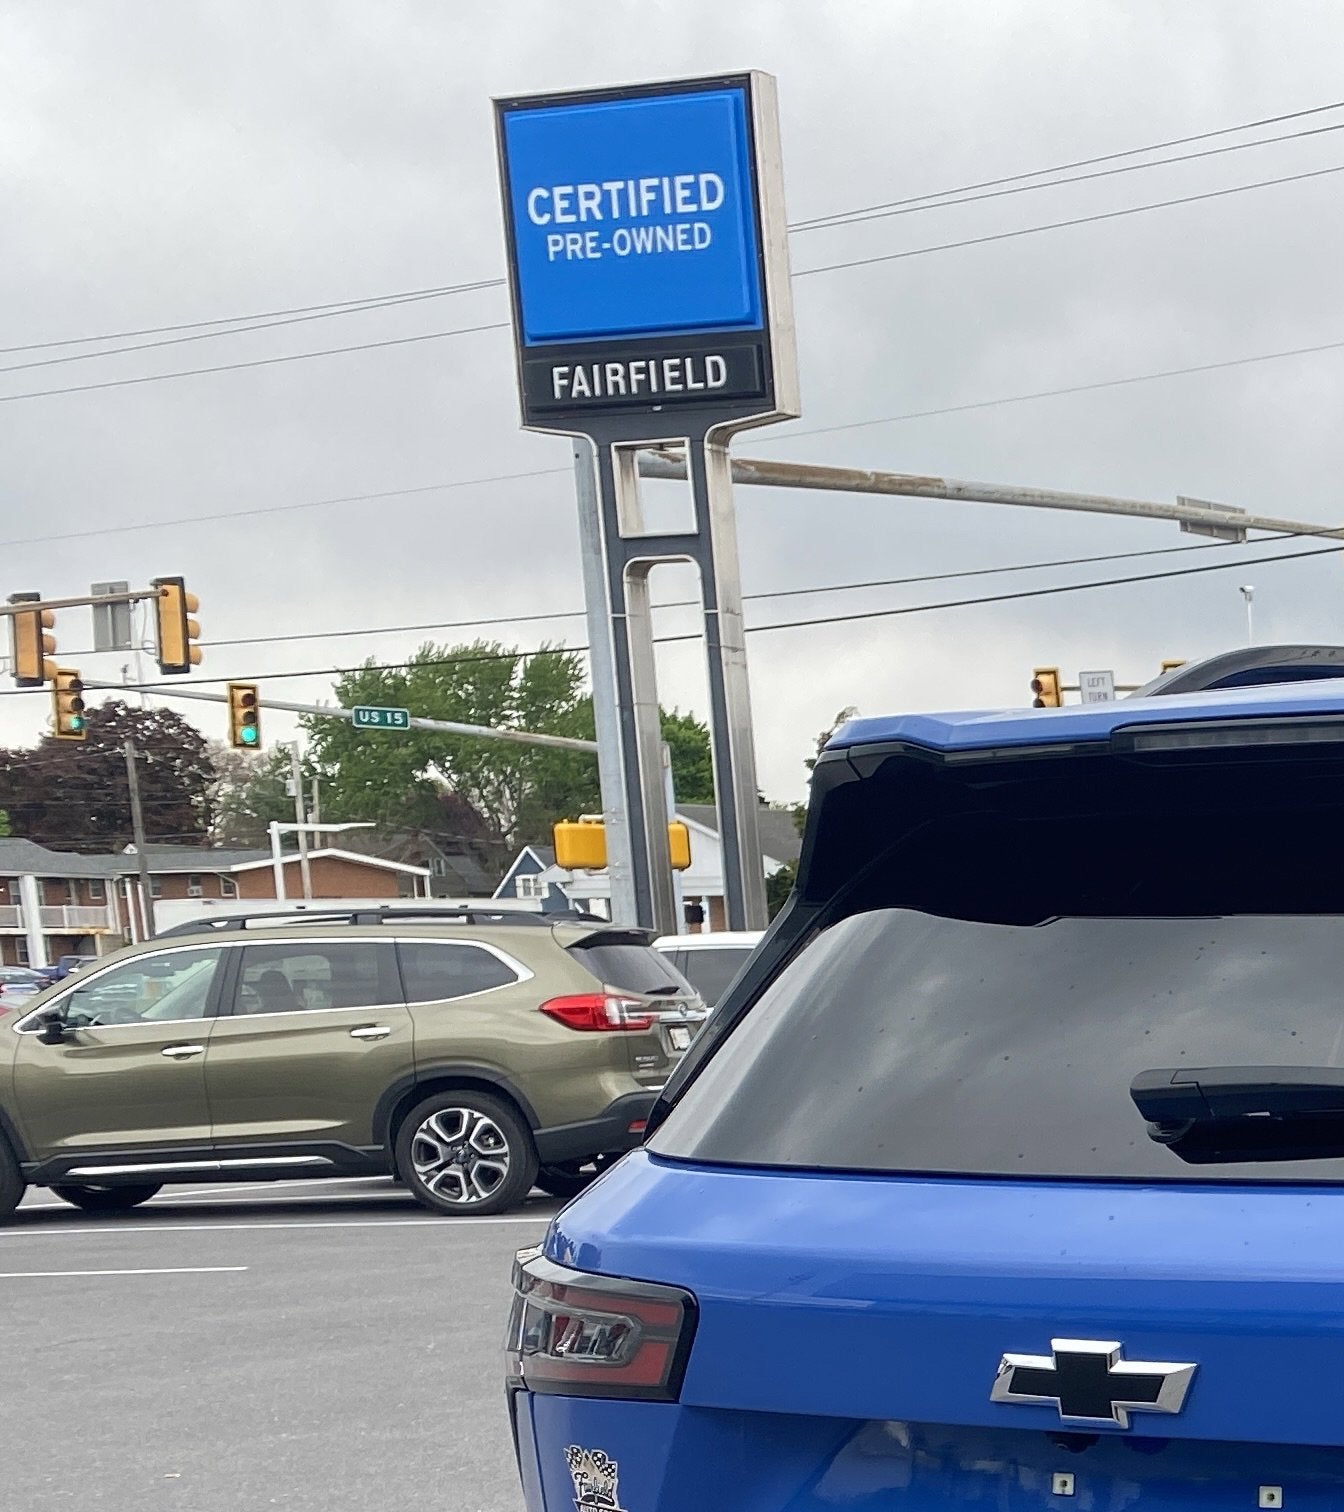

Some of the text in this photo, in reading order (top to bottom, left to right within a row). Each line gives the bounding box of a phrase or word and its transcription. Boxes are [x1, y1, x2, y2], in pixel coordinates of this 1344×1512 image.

[527, 173, 725, 225] CERTIFIED
[547, 222, 712, 261] PRE-OWNED
[552, 355, 727, 400] FAIRFIELD
[1087, 677, 1106, 688] LEFT
[359, 710, 403, 725] US 15
